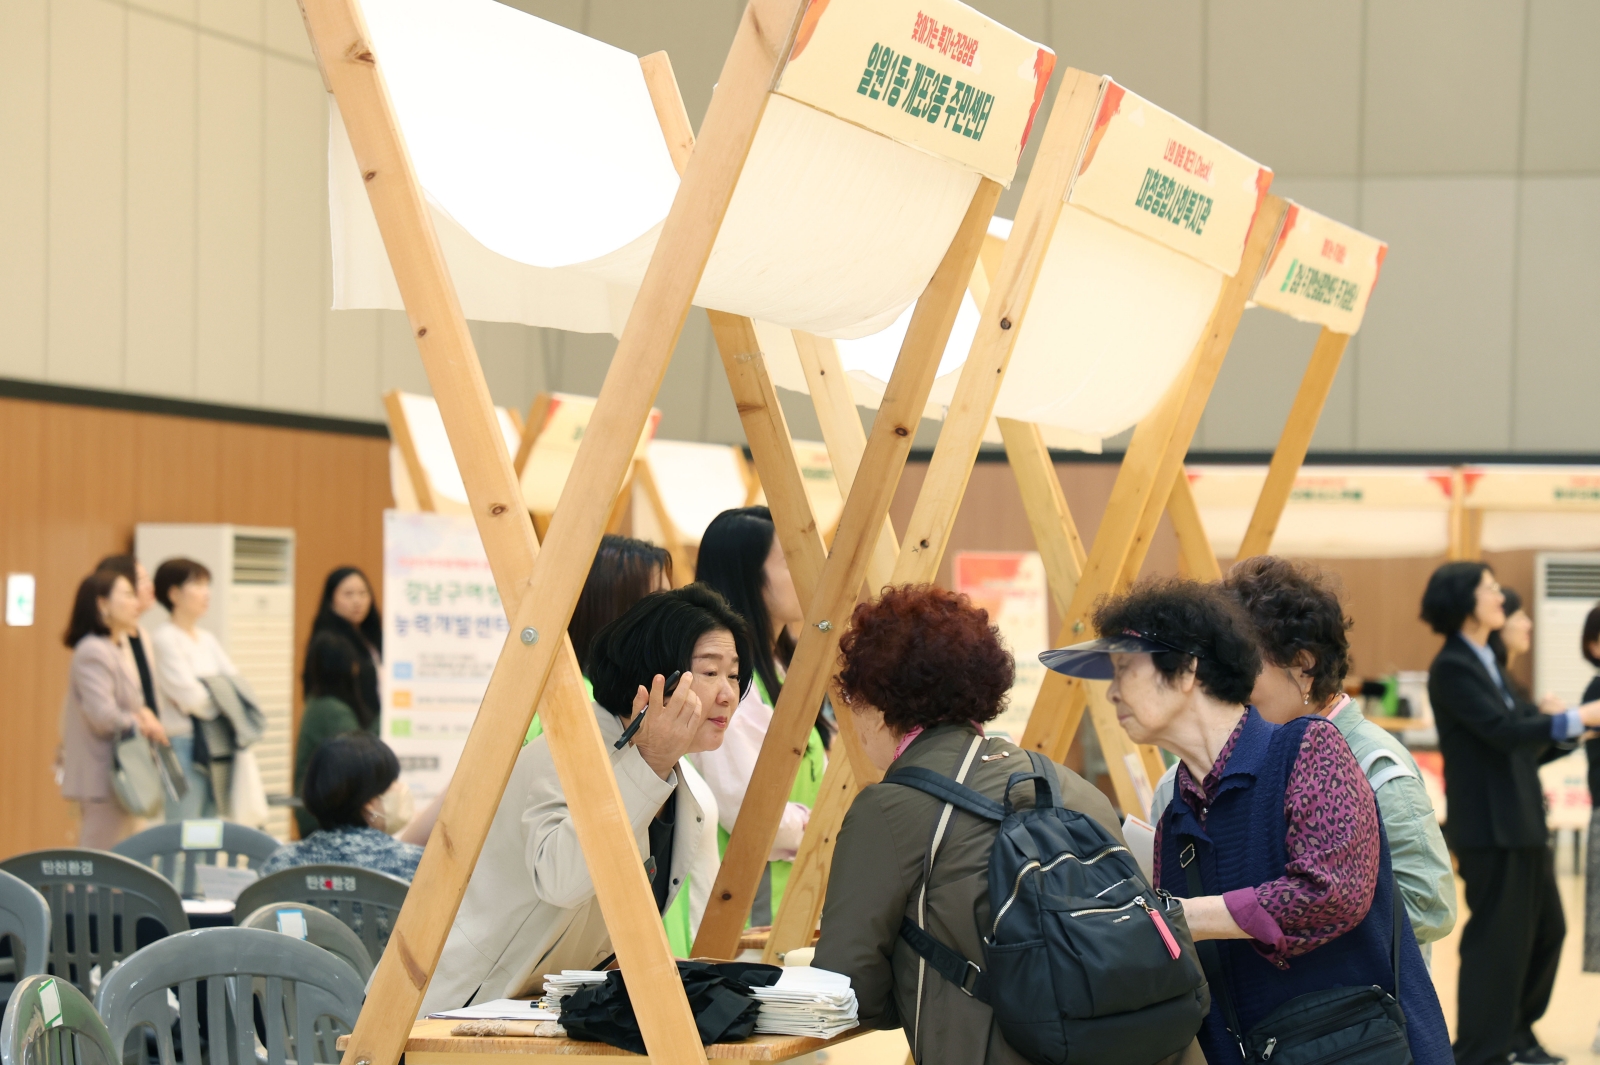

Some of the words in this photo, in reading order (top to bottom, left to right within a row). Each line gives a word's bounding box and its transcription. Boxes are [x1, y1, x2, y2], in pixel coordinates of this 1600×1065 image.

[911, 10, 939, 49] 찾아가는
[938, 25, 979, 67] 복지+건강상담
[944, 81, 995, 141] 주민센터
[1135, 167, 1214, 235] 대청종합사회복지관
